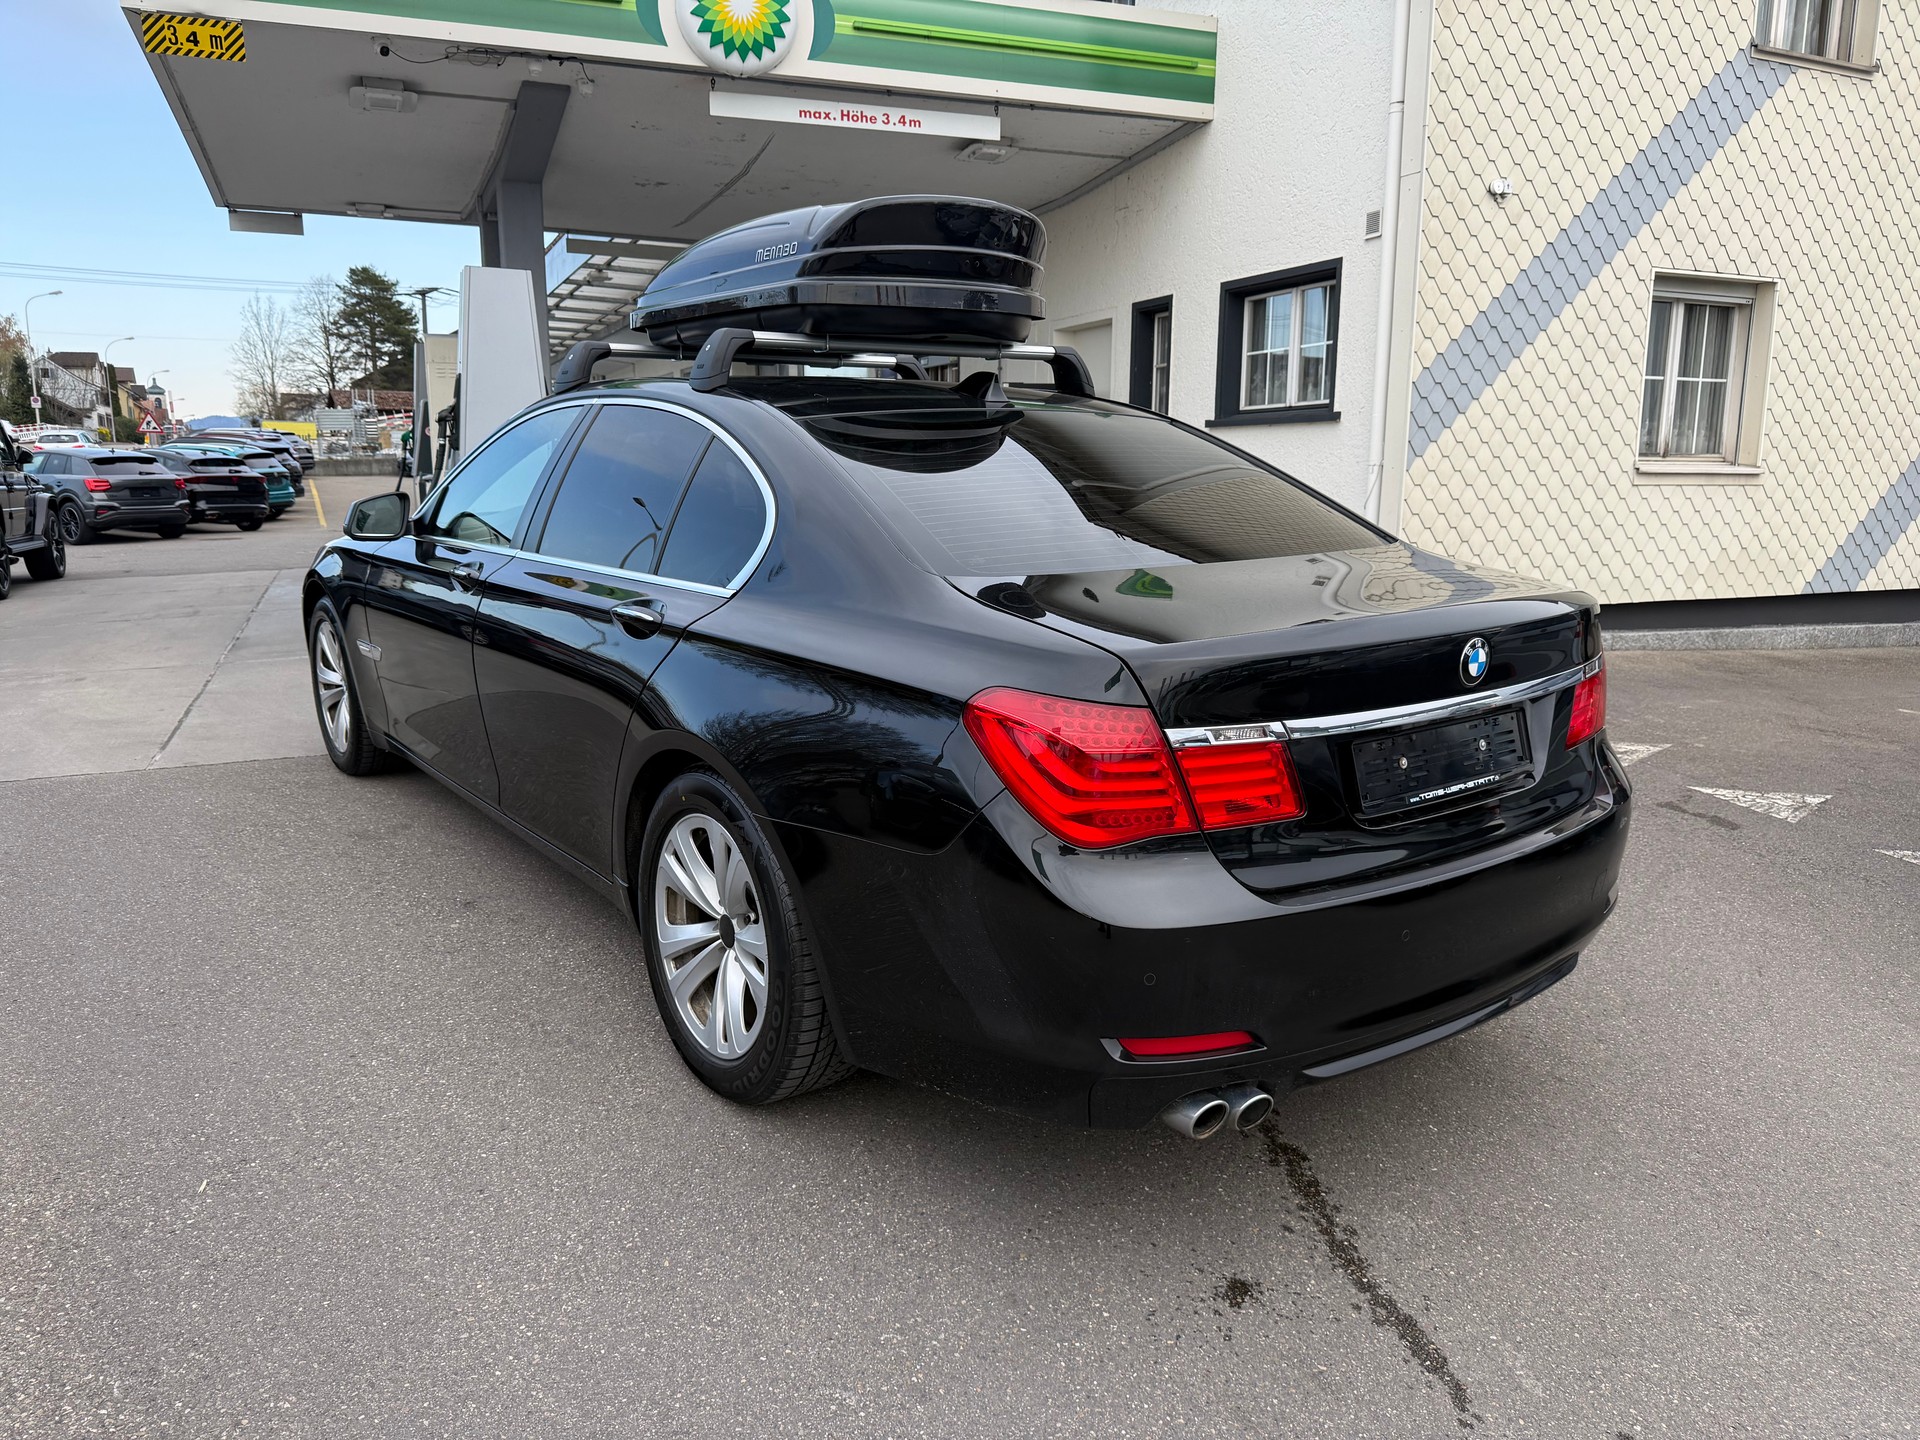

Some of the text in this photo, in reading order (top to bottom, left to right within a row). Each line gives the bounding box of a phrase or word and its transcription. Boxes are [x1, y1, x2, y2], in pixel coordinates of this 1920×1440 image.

[167, 24, 224, 51] 3.4 m
[799, 109, 837, 121] max.
[840, 109, 878, 124] Höhe
[720, 978, 784, 1094] GOODRID
